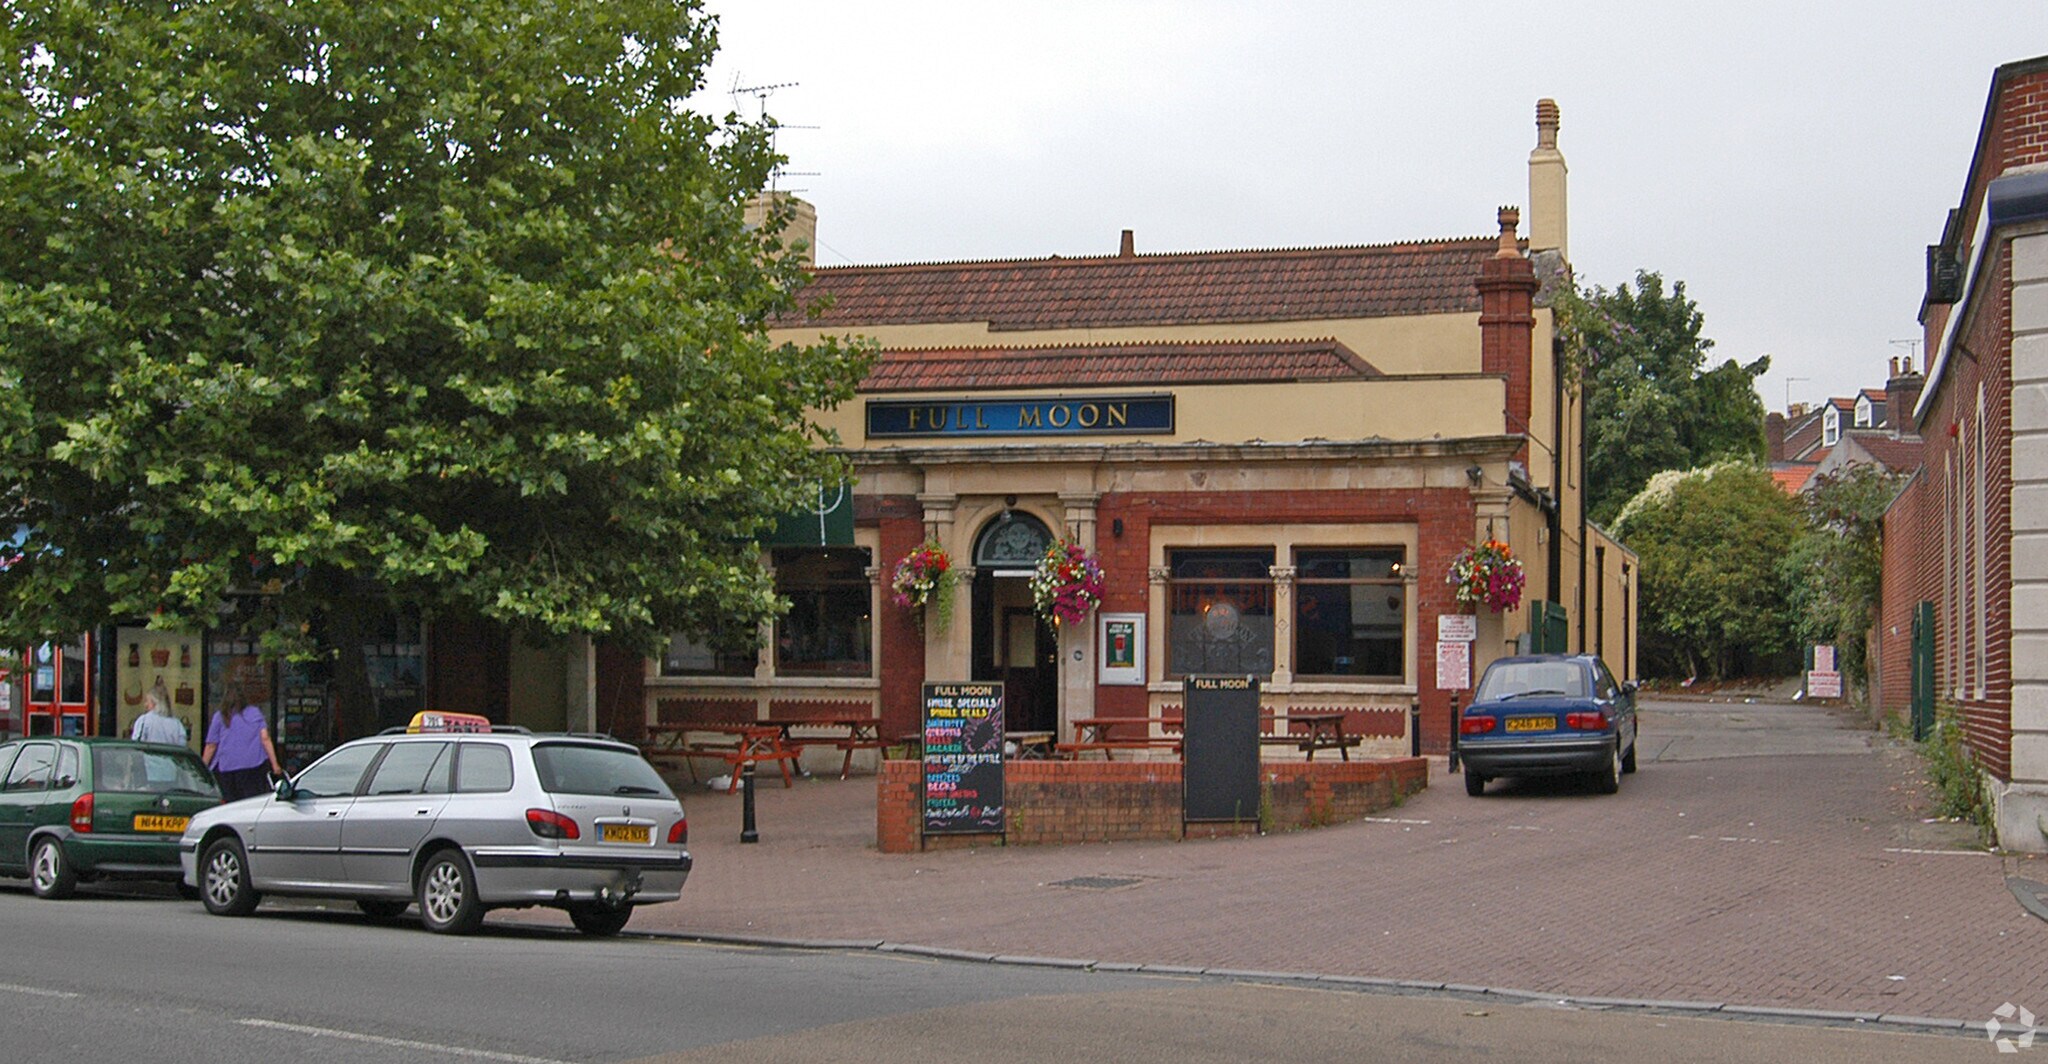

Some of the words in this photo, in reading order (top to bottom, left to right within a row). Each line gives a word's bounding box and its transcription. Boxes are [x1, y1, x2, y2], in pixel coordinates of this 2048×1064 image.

[908, 407, 989, 430] FULL
[1018, 403, 1129, 429] MOON
[1196, 679, 1218, 689] FULL
[1220, 679, 1249, 689] MOON
[935, 686, 958, 696] FULL
[961, 686, 992, 695] MOON
[444, 719, 480, 733] TAXI
